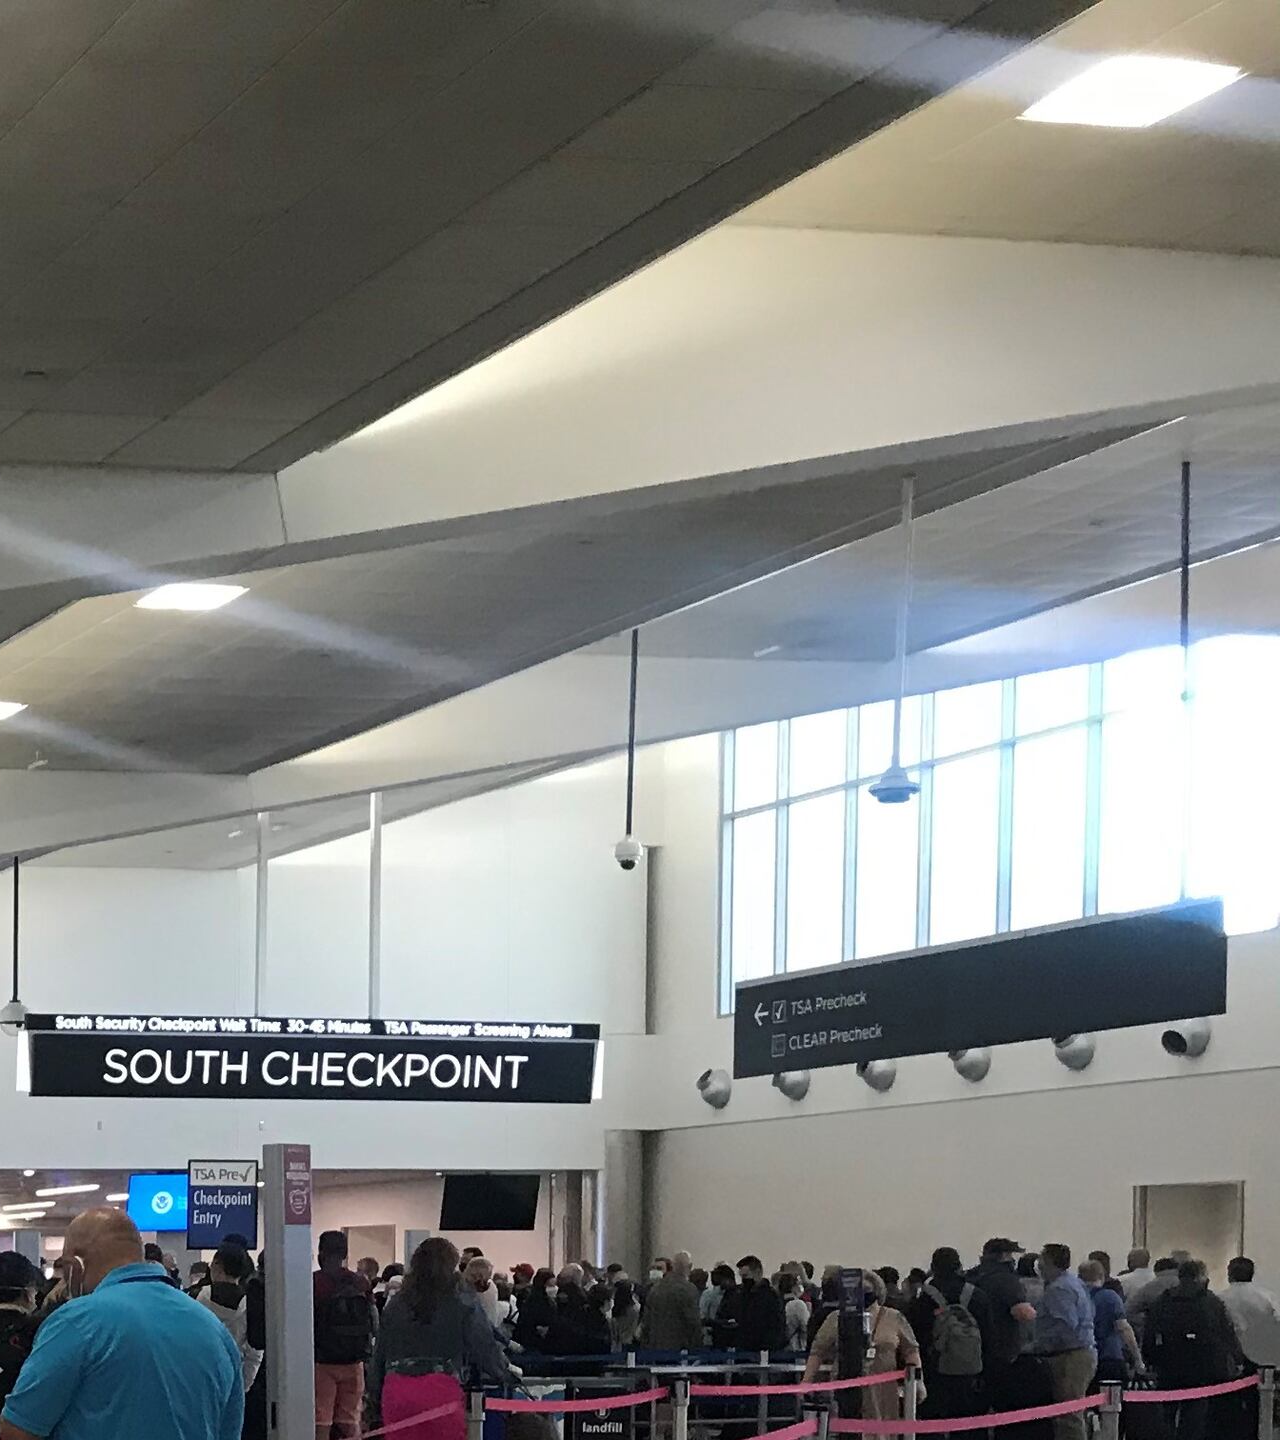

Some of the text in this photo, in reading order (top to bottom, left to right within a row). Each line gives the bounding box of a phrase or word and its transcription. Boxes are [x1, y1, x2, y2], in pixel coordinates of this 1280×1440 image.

[791, 991, 867, 1016] TSA Precheck
[55, 1015, 92, 1030] South
[95, 1016, 145, 1032] Security
[147, 1017, 217, 1033] Checkpoint
[219, 1018, 247, 1032] Wait
[327, 1020, 372, 1034] Minutes
[384, 1021, 408, 1036] TSA
[411, 1022, 472, 1038] Passenger
[473, 1023, 530, 1039] Screening
[532, 1024, 573, 1039] Ahead
[789, 1023, 882, 1050] CLEAR Precheck
[102, 1048, 530, 1089] SOUTH CHECKPOINT
[193, 1168, 216, 1180] TSA
[193, 1189, 252, 1209] Checkpoint
[193, 1209, 222, 1229] Entry
[582, 1421, 623, 1433] landfill
